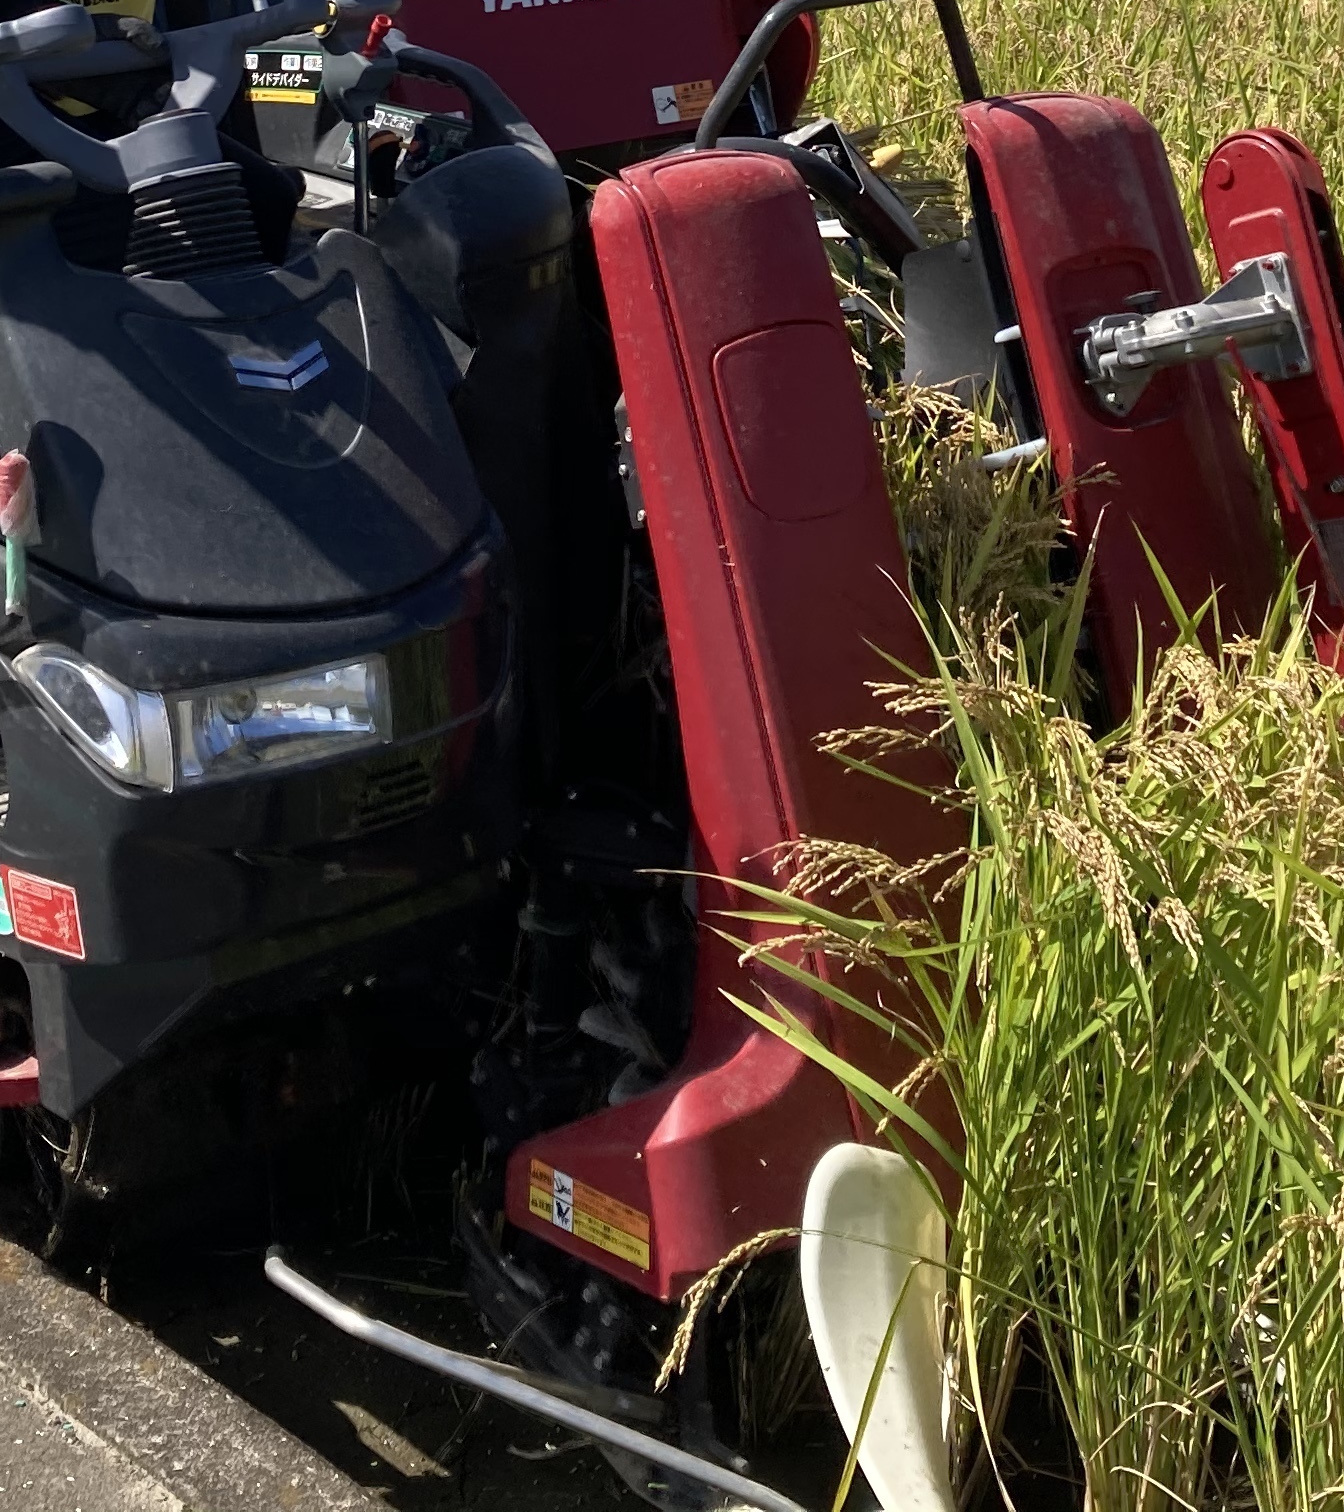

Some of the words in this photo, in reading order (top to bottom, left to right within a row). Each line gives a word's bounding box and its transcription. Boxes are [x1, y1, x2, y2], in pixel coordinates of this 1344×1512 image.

[251, 72, 310, 88] サイドデバイダー
